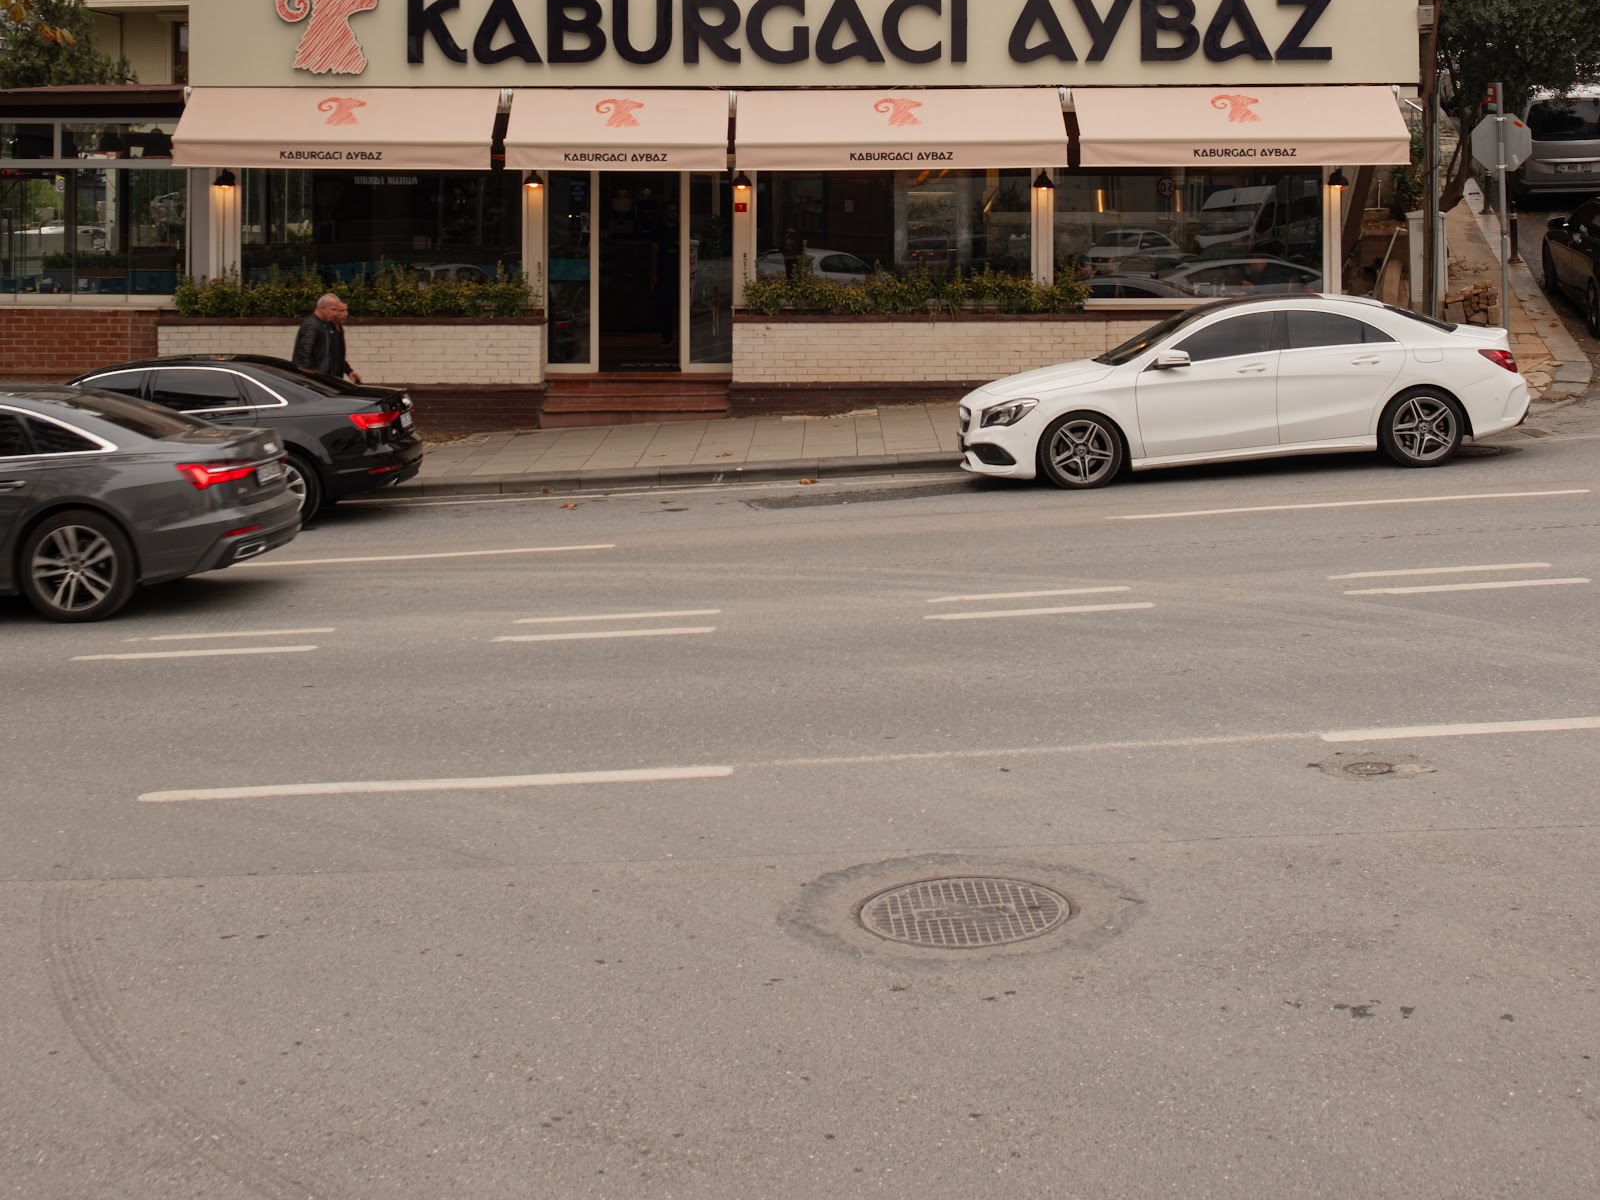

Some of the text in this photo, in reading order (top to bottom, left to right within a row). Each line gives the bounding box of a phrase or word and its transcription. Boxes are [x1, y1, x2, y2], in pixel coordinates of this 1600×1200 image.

[279, 150, 382, 161] KABURGACI AYBAZ
[564, 152, 668, 162] KABURGACI AYBAZ
[849, 151, 954, 161] KABURGACI AYBAZ
[1193, 147, 1297, 158] KABURGACI AYBAZ
